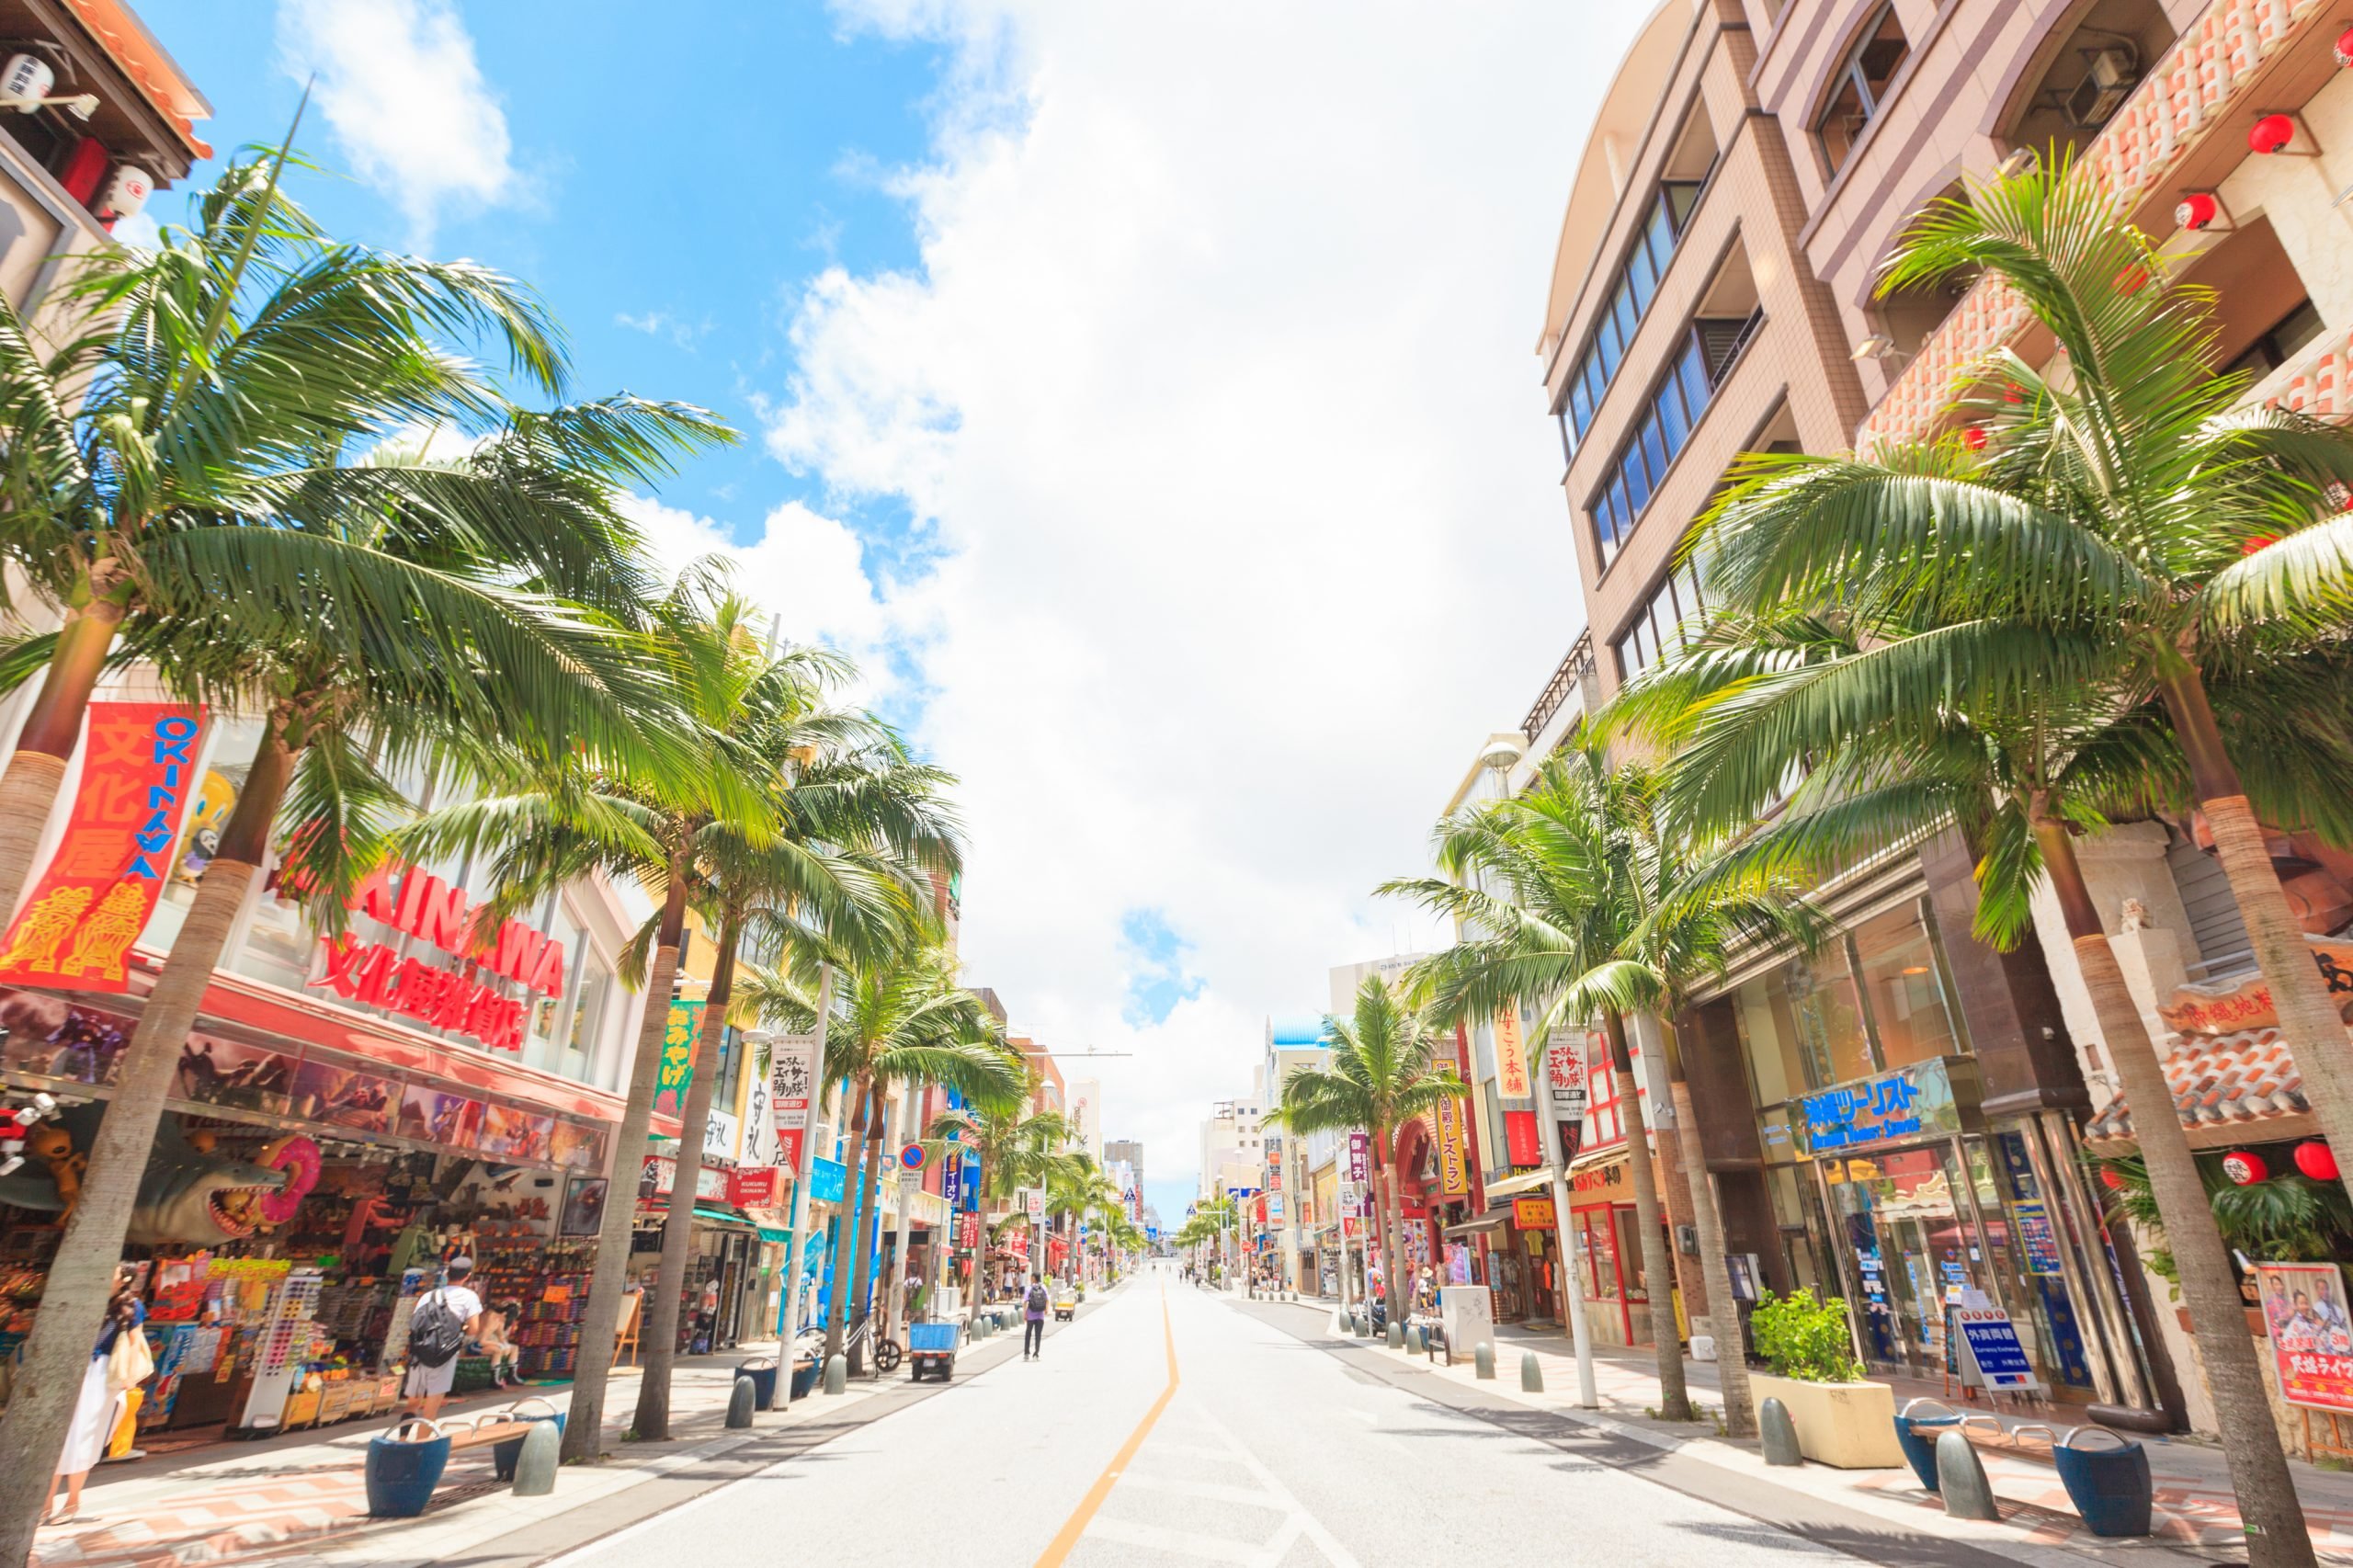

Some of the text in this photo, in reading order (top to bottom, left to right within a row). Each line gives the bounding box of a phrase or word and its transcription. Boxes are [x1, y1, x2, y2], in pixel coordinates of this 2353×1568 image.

[55, 717, 151, 880] 文化屋
[120, 717, 199, 880] OKINAWA
[278, 818, 563, 999] KINAWA
[662, 1007, 688, 1085] おみやげ
[747, 1082, 766, 1160] 守礼
[1802, 1076, 1918, 1129] 沖縄ツーリスト
[947, 1172, 958, 1201] イーオン
[1350, 1139, 1363, 1178] 御菓子
